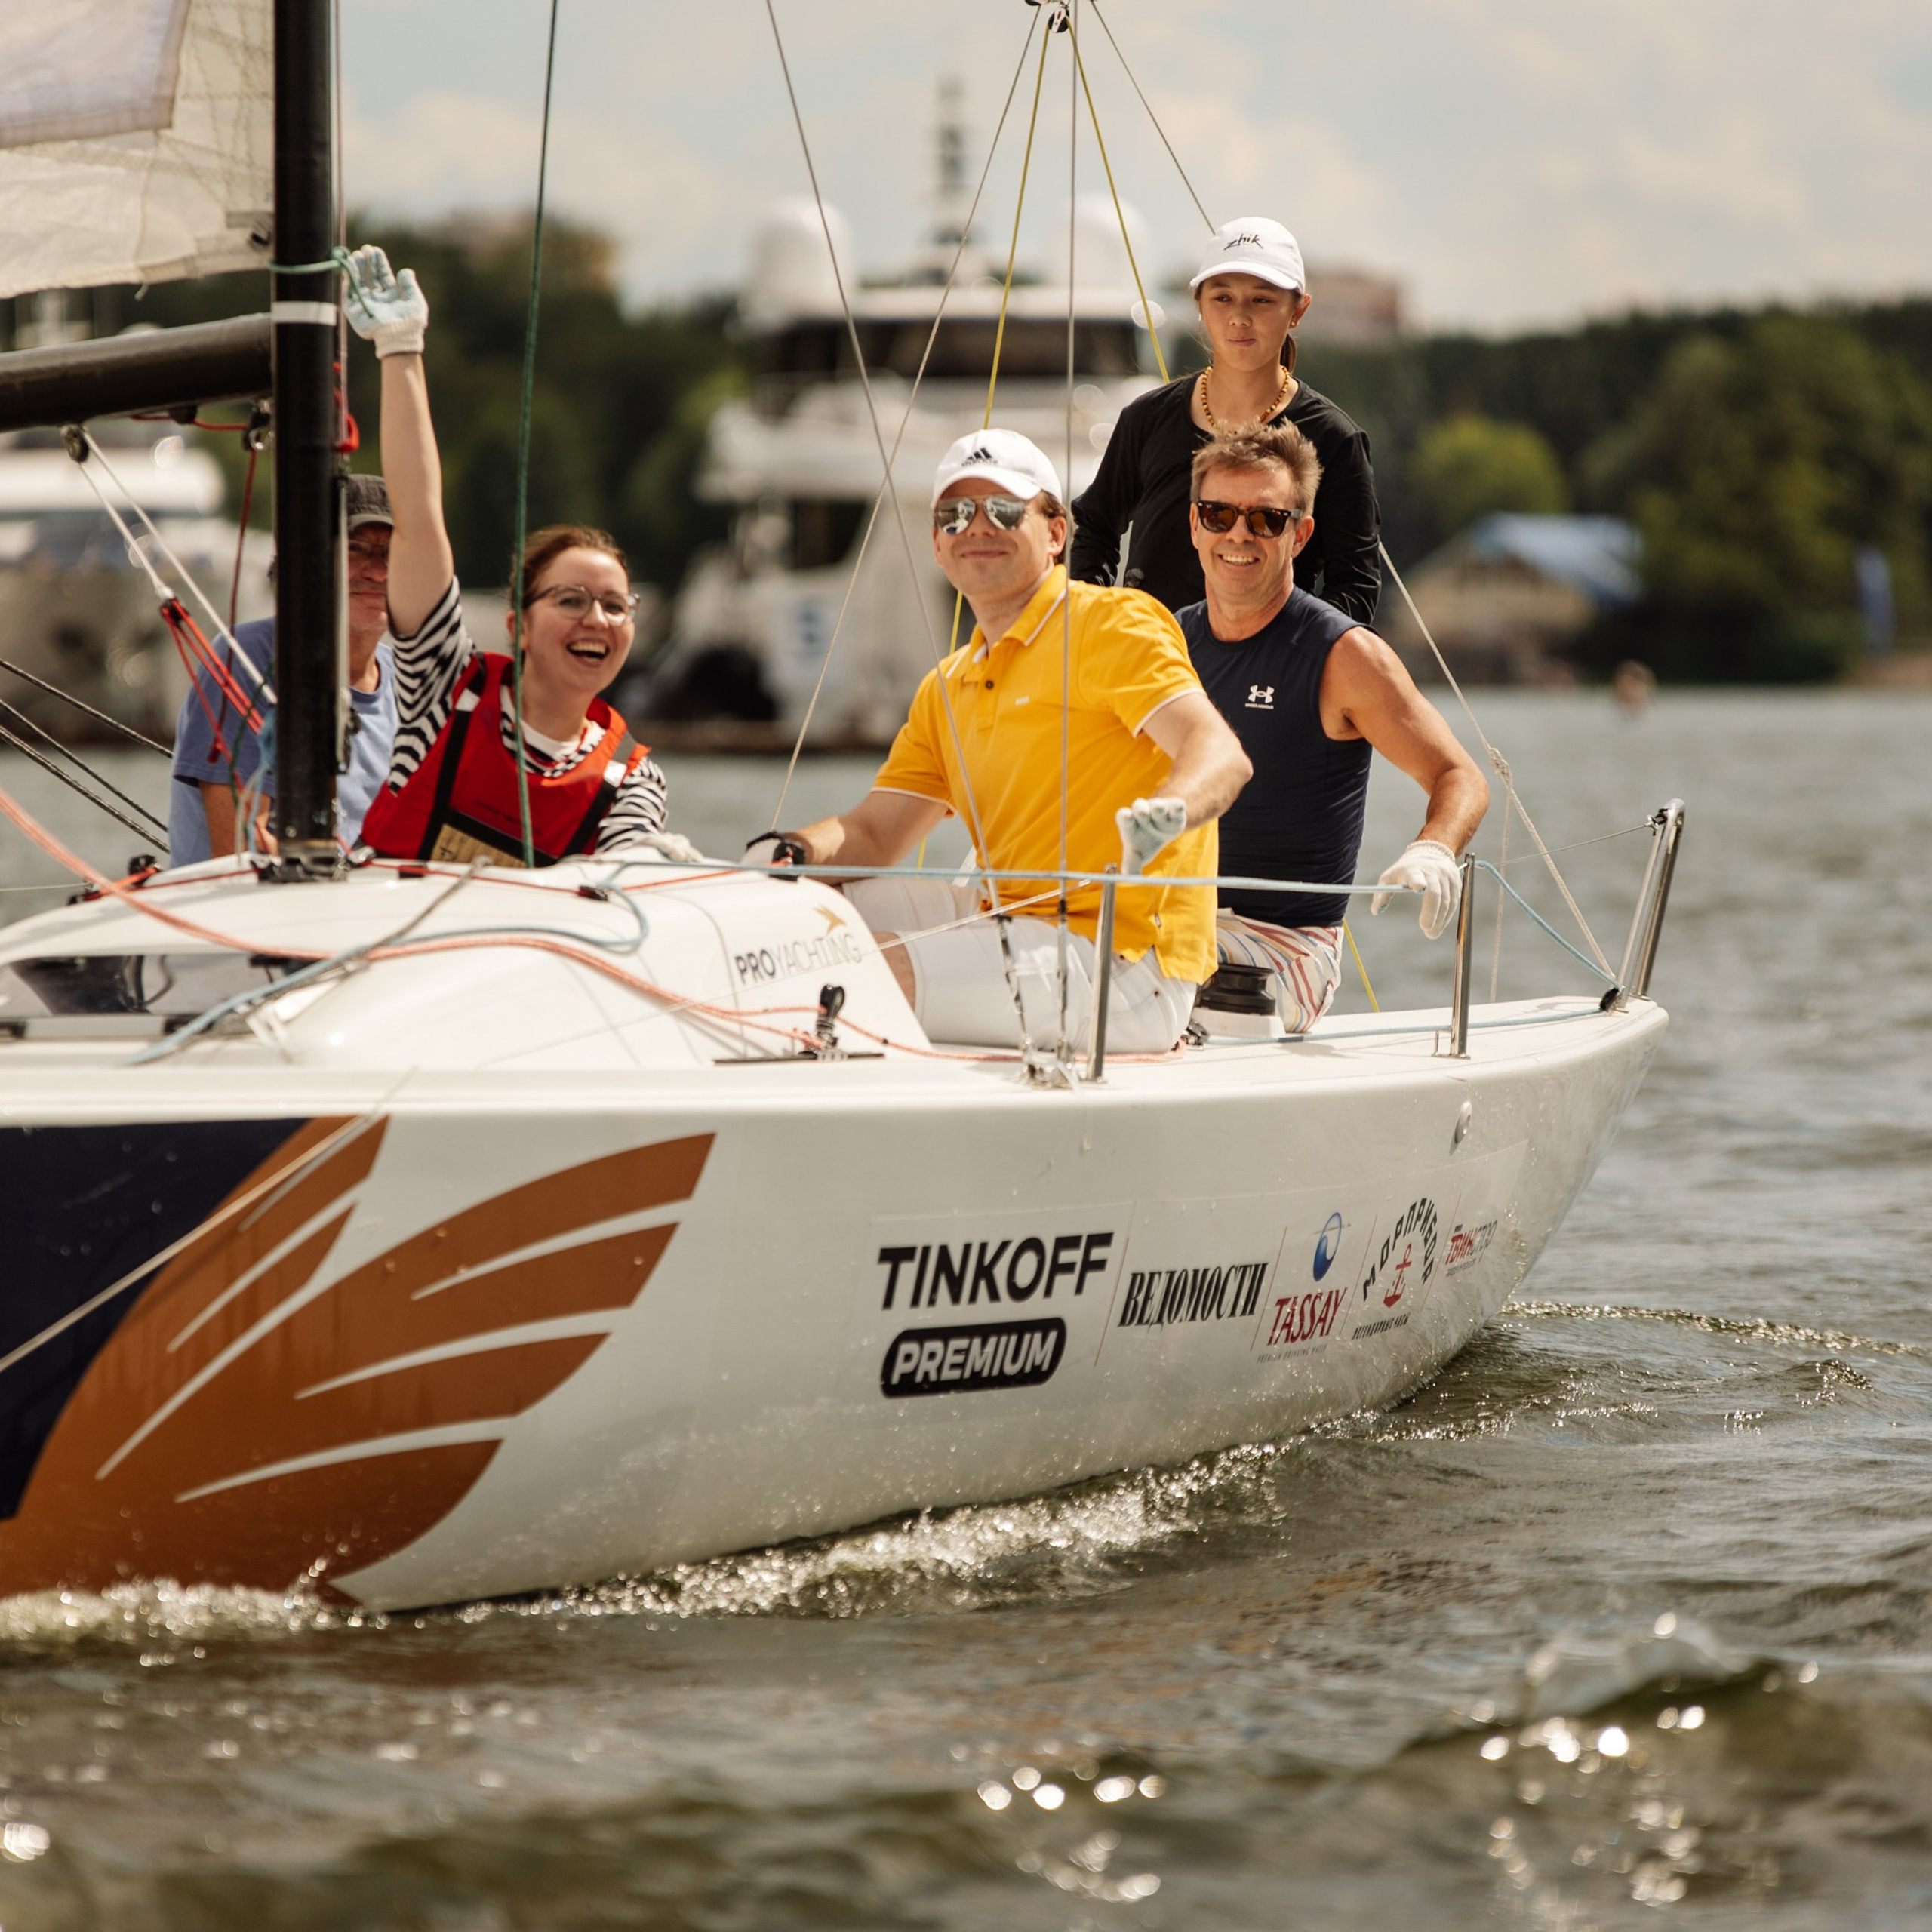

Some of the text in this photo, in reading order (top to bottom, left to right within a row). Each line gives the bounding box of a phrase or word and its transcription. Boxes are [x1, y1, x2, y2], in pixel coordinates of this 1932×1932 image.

[734, 933, 863, 985] PROYACHTING
[878, 1232, 1114, 1311] TINKOFF
[1118, 1262, 1269, 1334] ВЕДОМОСТИ
[1266, 1287, 1349, 1346] TASSAY
[891, 1331, 1058, 1386] PREMIUM
